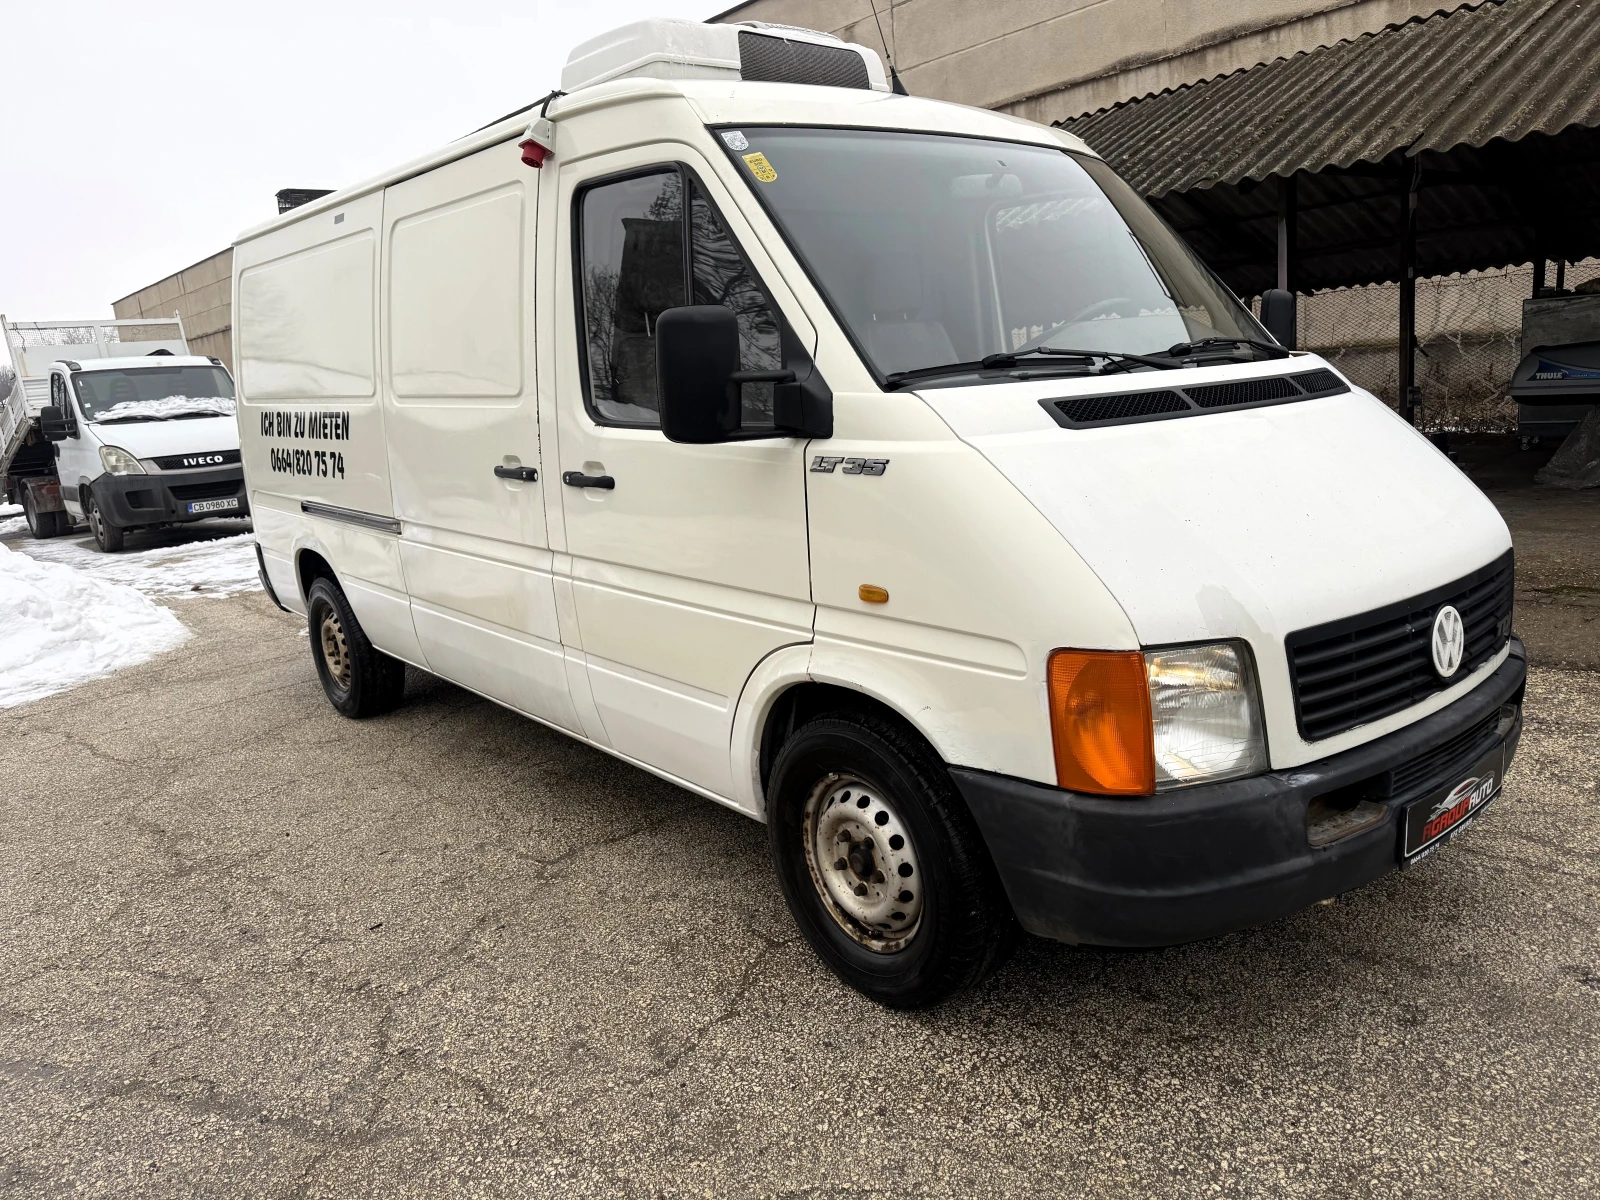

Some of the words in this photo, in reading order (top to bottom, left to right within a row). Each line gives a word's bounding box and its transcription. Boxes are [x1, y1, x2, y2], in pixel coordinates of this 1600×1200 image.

[1536, 372, 1563, 380] THULE
[261, 411, 274, 437] ICH
[276, 411, 291, 438] BIN
[294, 411, 306, 439] ZU
[308, 411, 350, 441] MIETEN
[183, 455, 224, 466] IVECO
[314, 450, 328, 478] 75
[329, 451, 345, 480] 74
[809, 455, 845, 474] LT
[842, 457, 890, 477] 35
[193, 503, 205, 512] CB
[205, 500, 226, 510] 0980
[226, 499, 237, 508] XC
